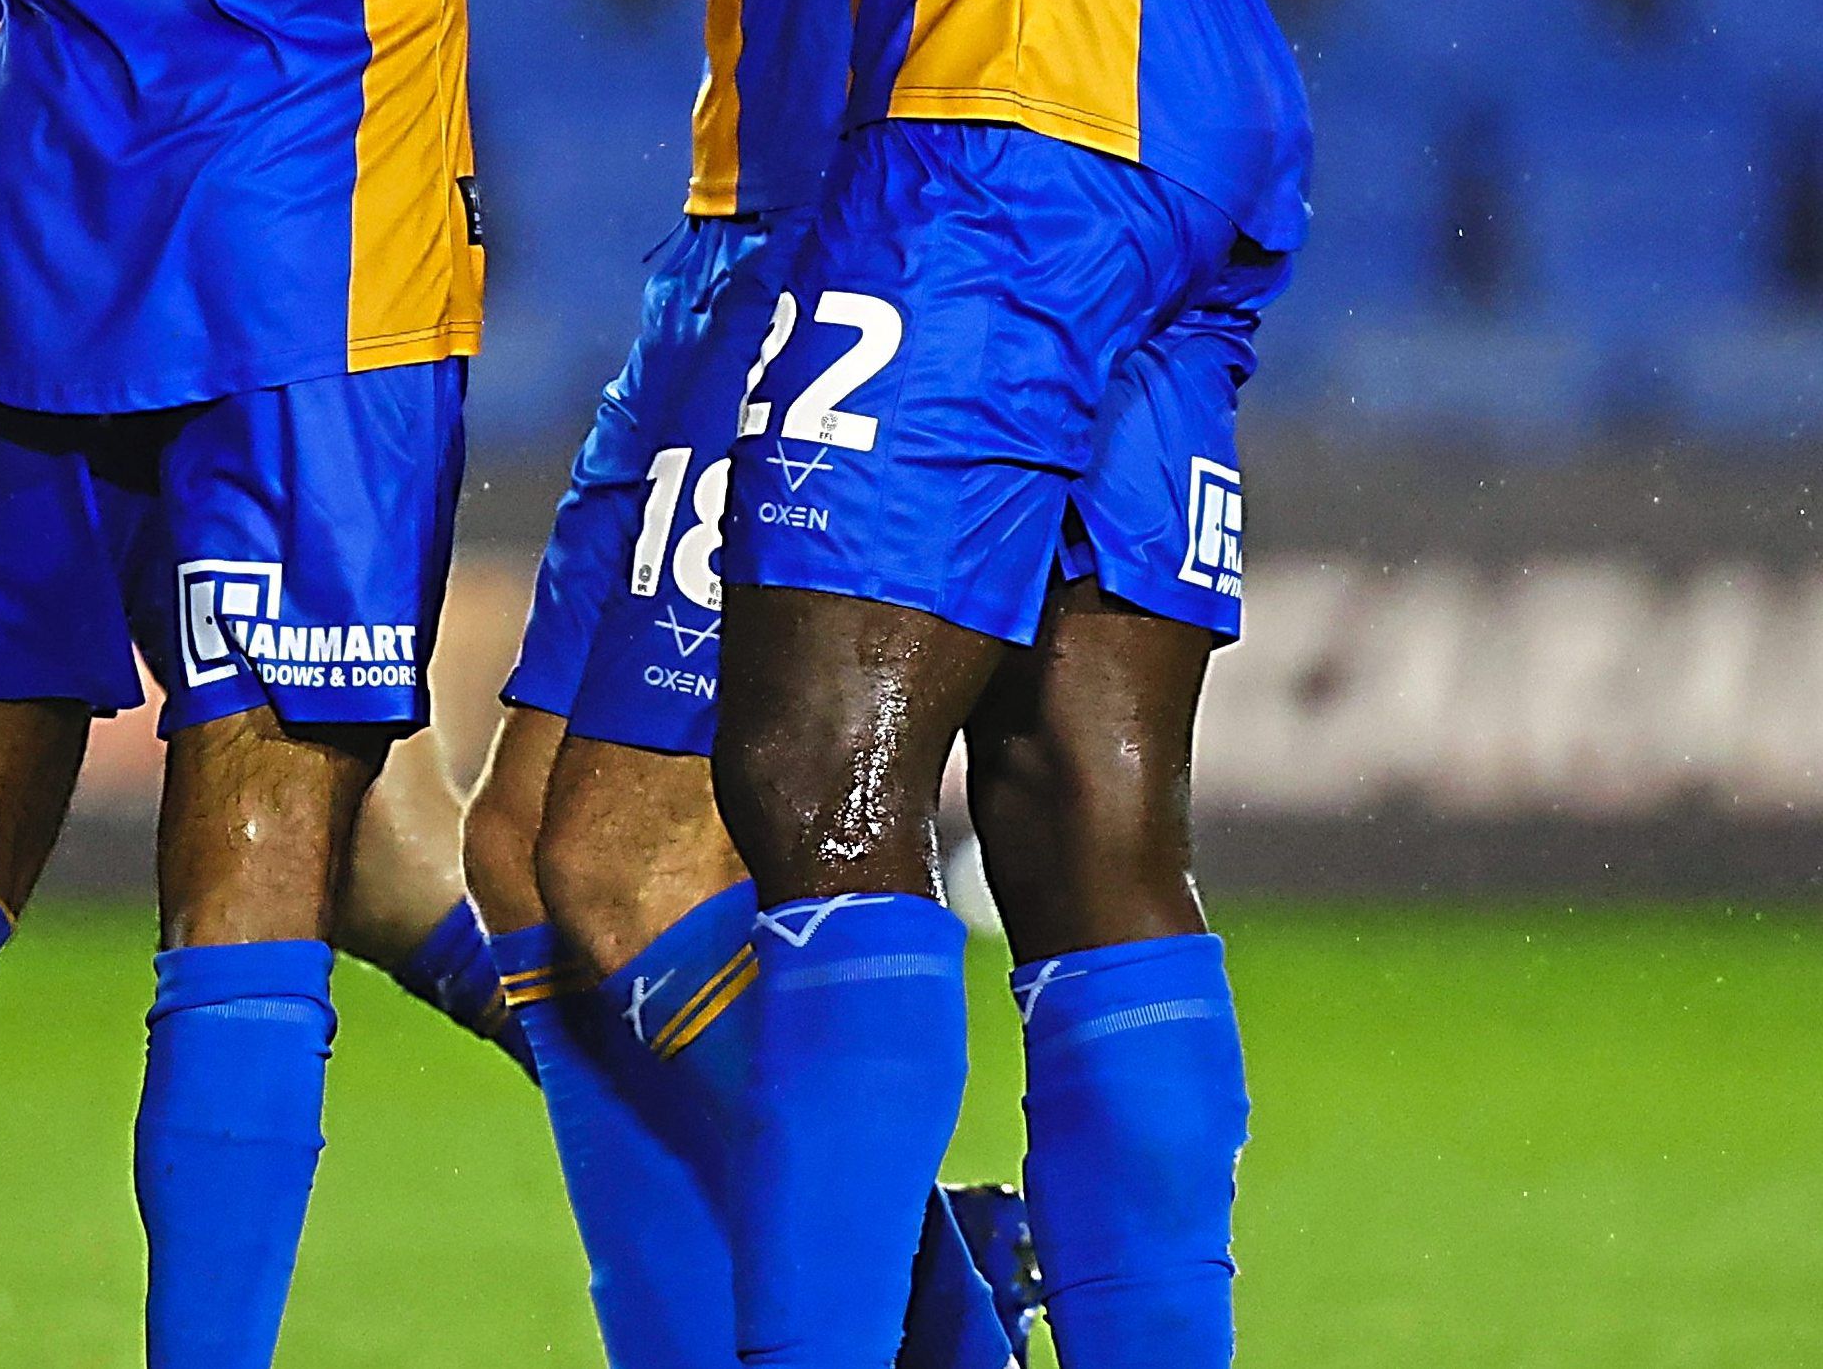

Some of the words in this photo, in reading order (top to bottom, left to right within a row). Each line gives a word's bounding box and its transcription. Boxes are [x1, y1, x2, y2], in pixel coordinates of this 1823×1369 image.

[818, 431, 834, 441] EFL
[758, 502, 829, 531] OXEN
[329, 667, 346, 687] &
[644, 665, 717, 700] OXEN
